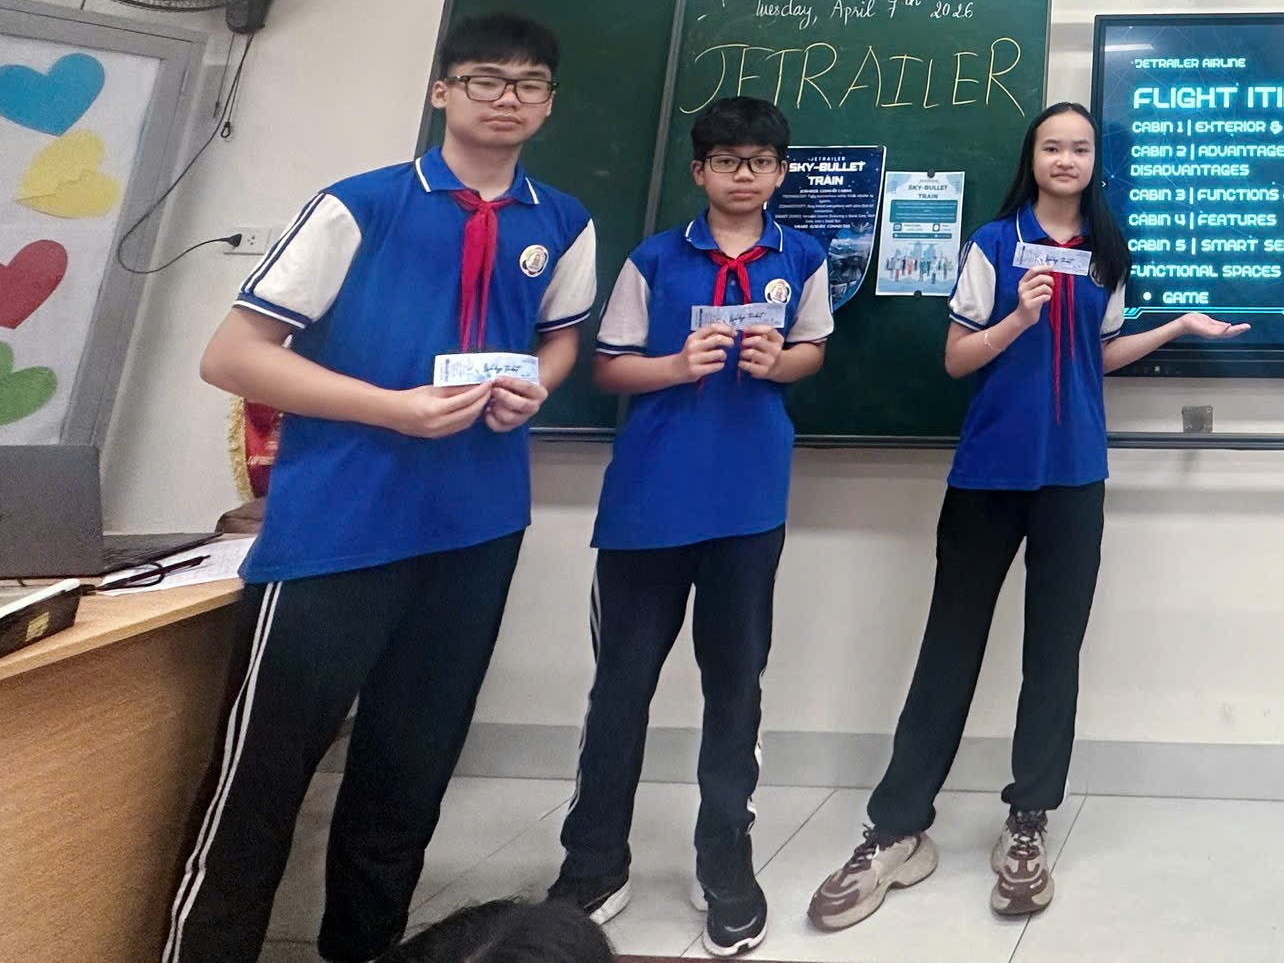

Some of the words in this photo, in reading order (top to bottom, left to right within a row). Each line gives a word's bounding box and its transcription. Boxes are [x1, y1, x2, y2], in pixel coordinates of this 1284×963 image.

[931, 1, 974, 19] 2026
[1135, 58, 1199, 69] JETRAILER
[1202, 57, 1246, 68] AIRLINE
[680, 37, 1025, 117] JETRAILER
[1133, 87, 1238, 109] FLIGHT
[1131, 121, 1174, 133] CABIN
[1177, 121, 1184, 133] 1
[1195, 121, 1266, 133] EXTERIOR
[1270, 121, 1283, 135] &
[1131, 145, 1173, 157] CABIN
[1176, 146, 1187, 157] 2
[789, 161, 866, 172] SKY-BULLET
[1130, 164, 1250, 177] DISADVANTAGES
[808, 175, 844, 186] TRAIN
[1130, 188, 1171, 201] CABIN
[1175, 188, 1186, 201] 3
[1198, 188, 1280, 201] FUNCTIONS
[1129, 213, 1171, 226] CABIN
[1175, 213, 1186, 226] 4
[1198, 213, 1277, 226] FEATURES
[1128, 239, 1170, 252] CABIN
[1175, 239, 1186, 252] 5
[1201, 239, 1259, 252] SMART
[1131, 265, 1218, 278] FUNCTIONAL
[1223, 265, 1281, 278] SPACES
[1162, 291, 1209, 304] GAME
